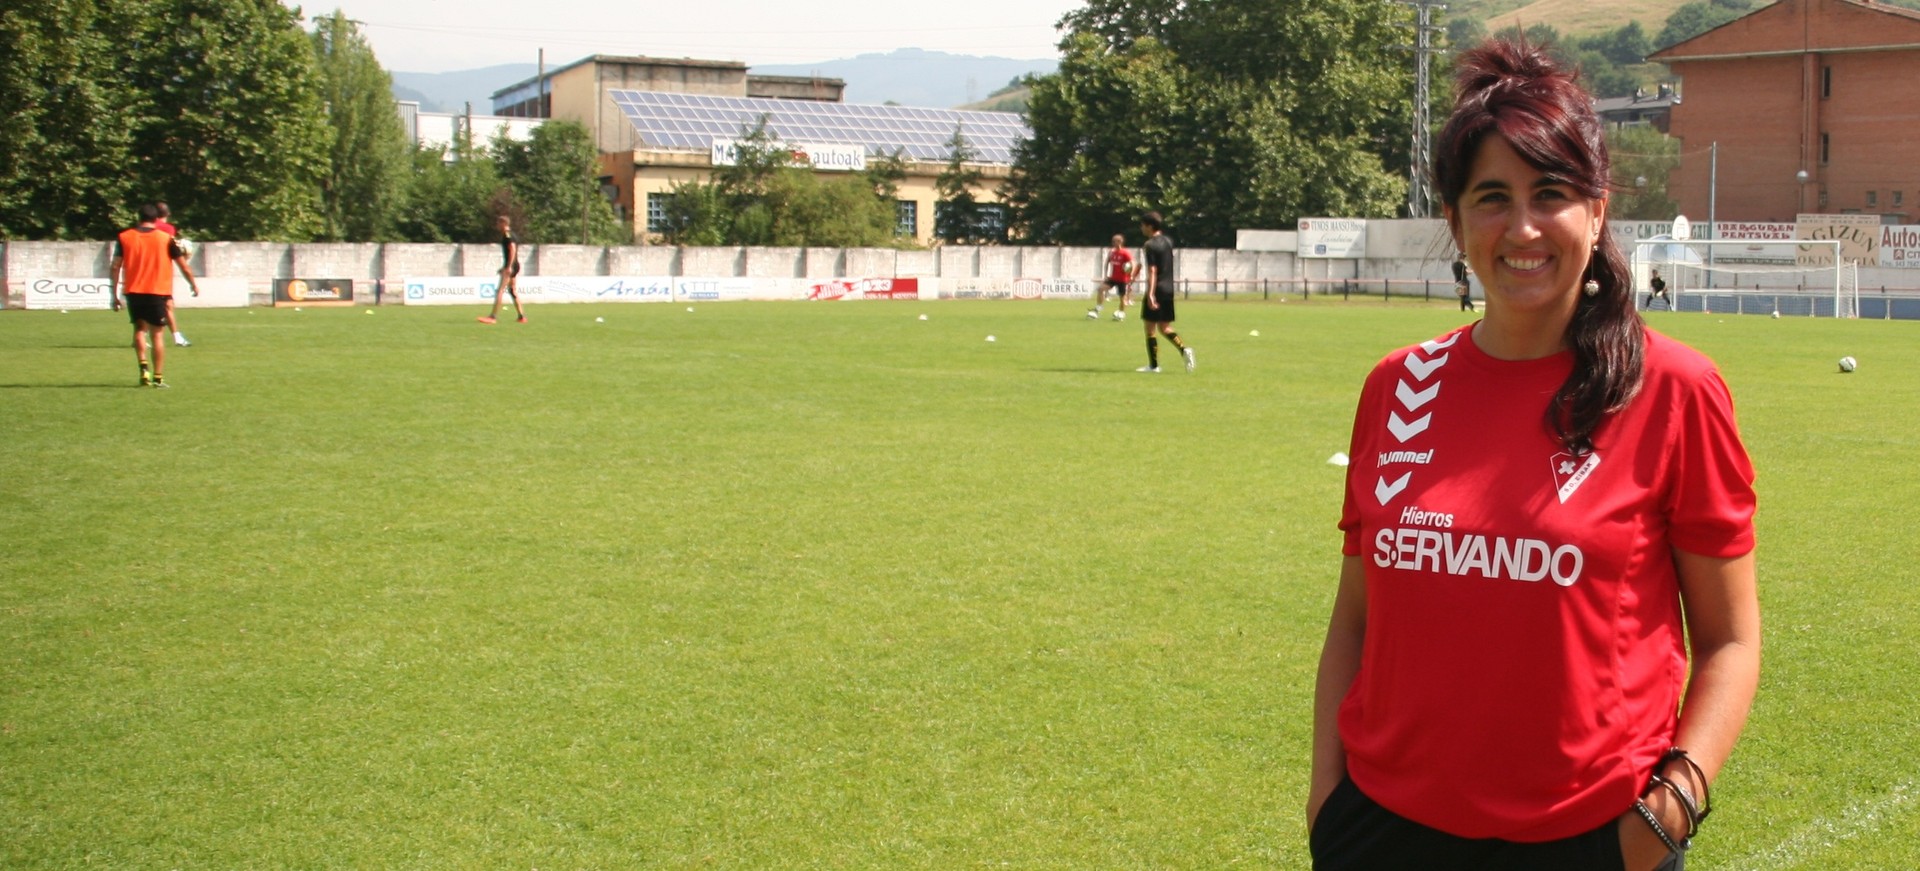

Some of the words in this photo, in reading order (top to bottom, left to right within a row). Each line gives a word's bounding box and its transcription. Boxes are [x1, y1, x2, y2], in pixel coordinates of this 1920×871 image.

[813, 148, 861, 166] autoak
[1717, 223, 1794, 232] IBARGUREN
[1797, 255, 1876, 266] OKINEGIA
[428, 287, 475, 296] SORALUCE
[597, 280, 670, 296] Araba
[1014, 279, 1041, 299] FILBER
[1042, 285, 1071, 293] FILBER
[1376, 448, 1434, 469] hummel
[1575, 462, 1593, 481] EIBAR
[1399, 505, 1454, 528] Hierros
